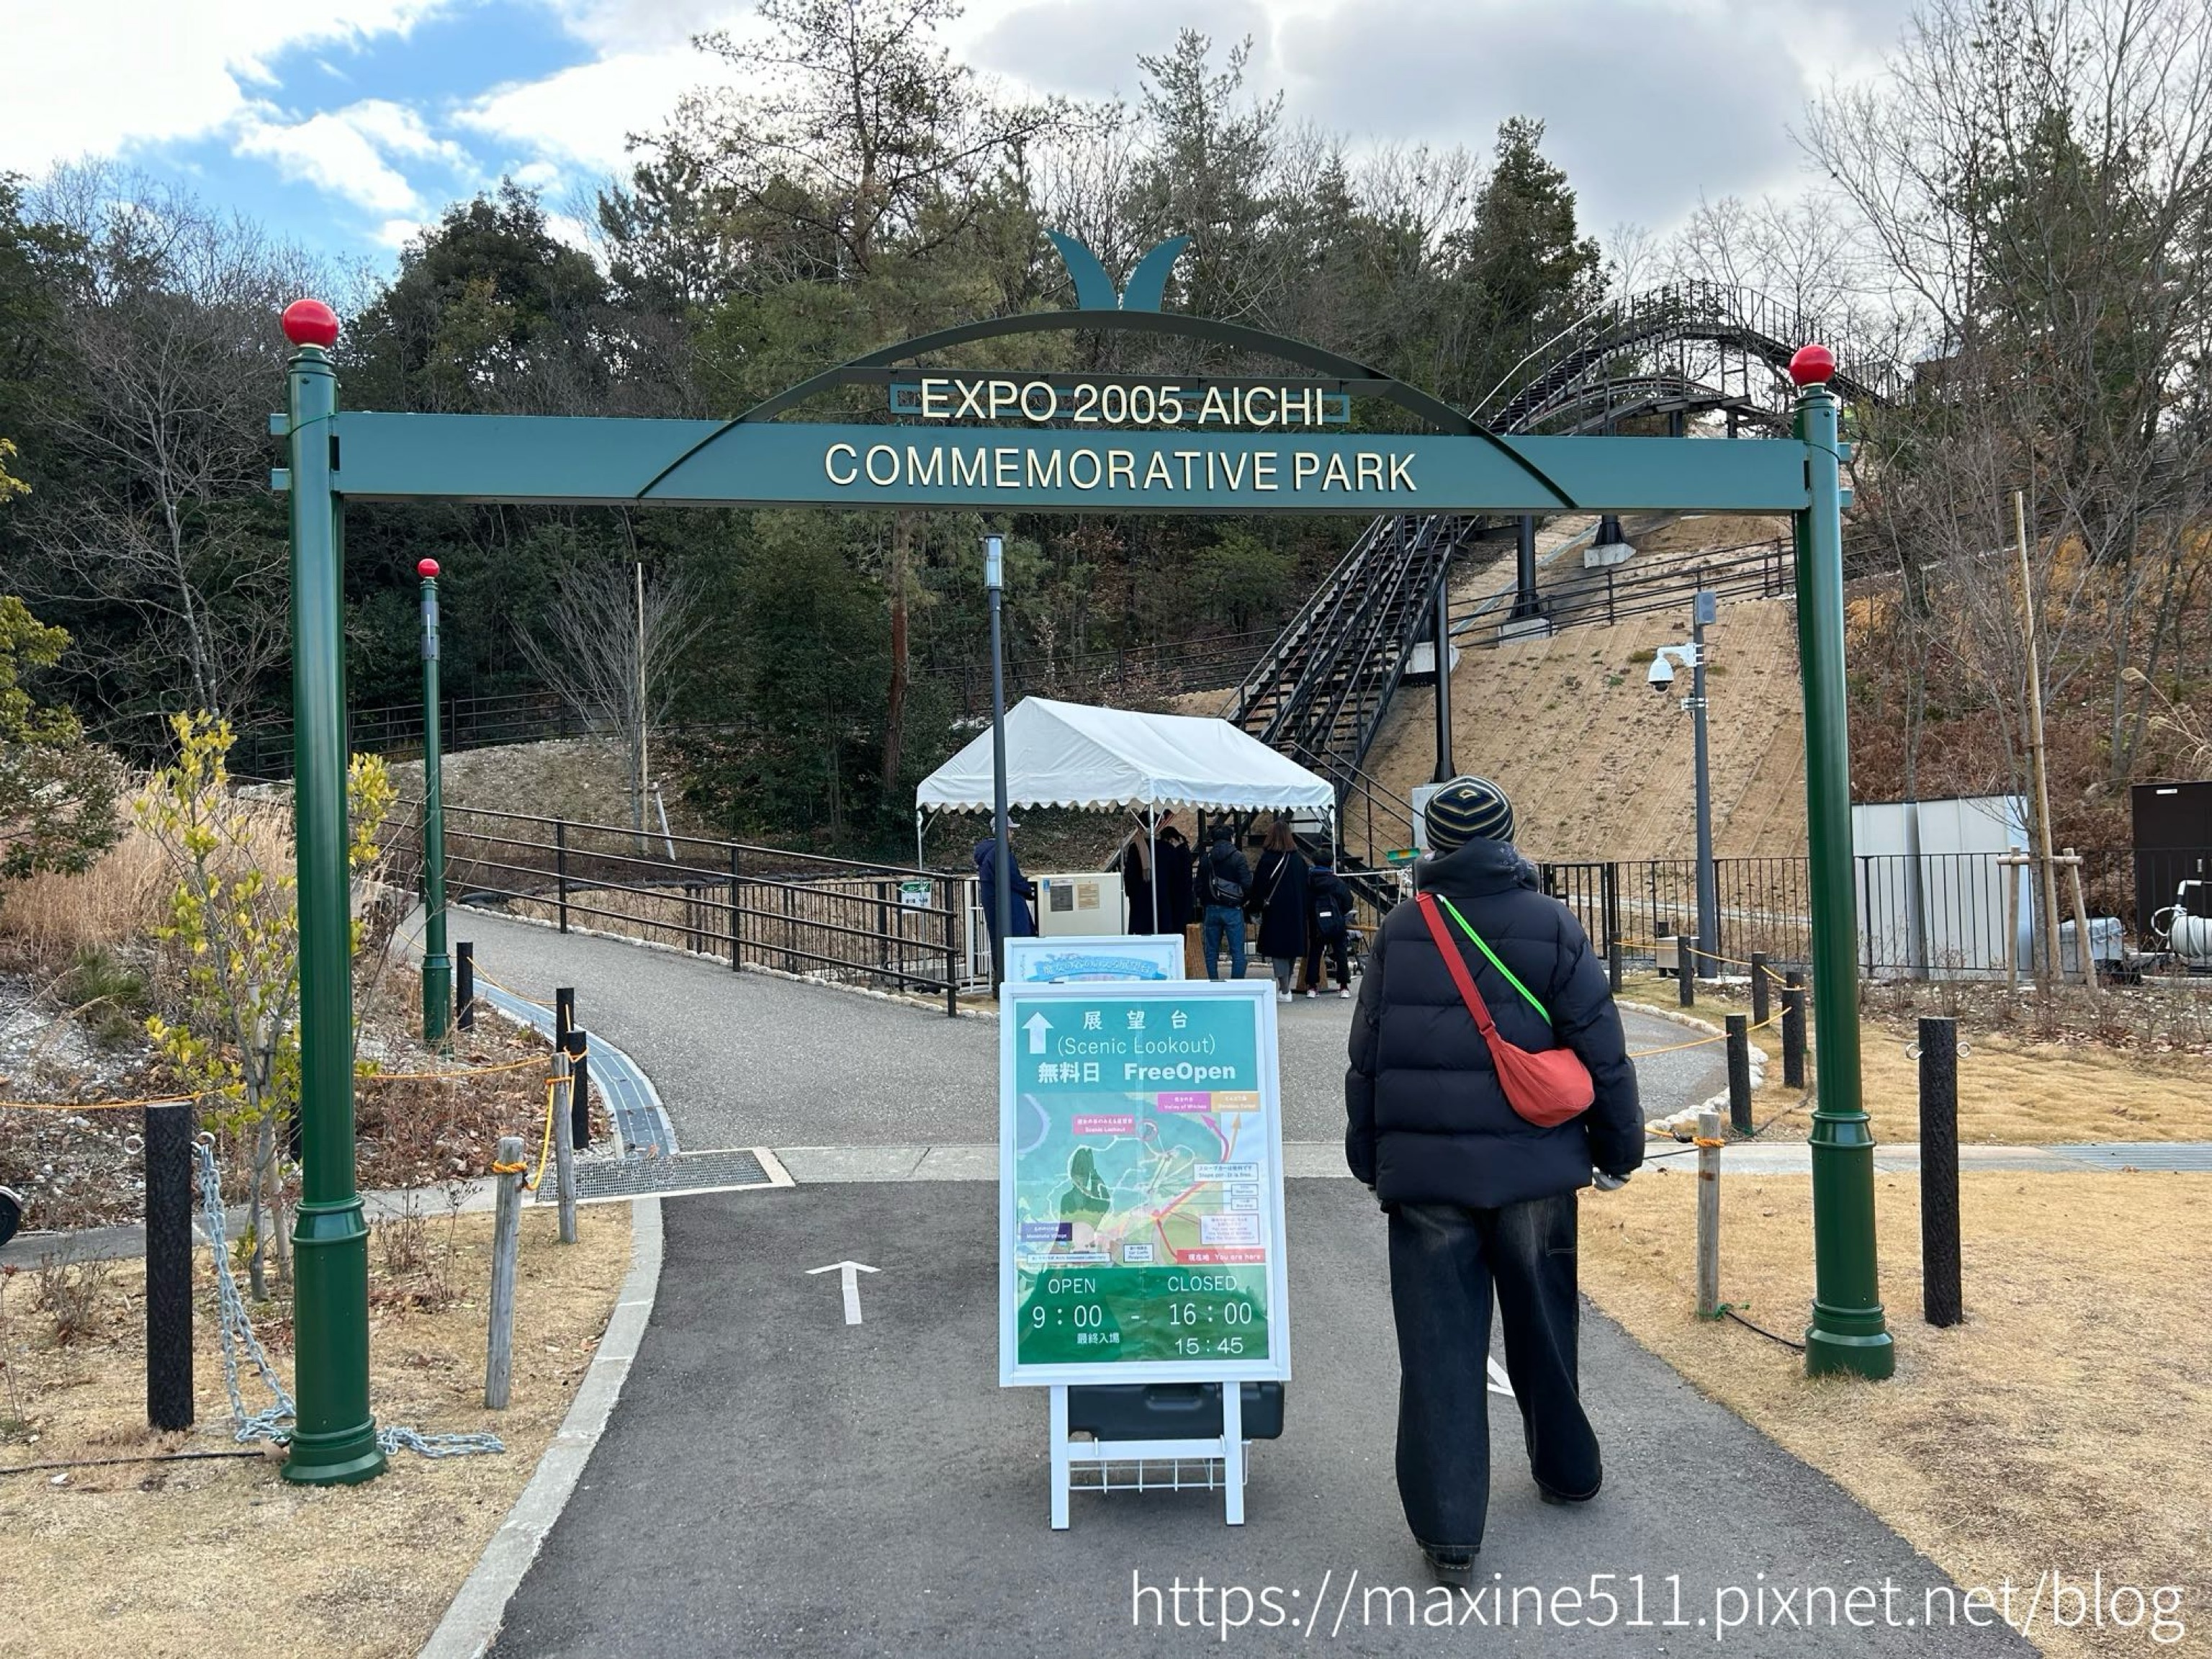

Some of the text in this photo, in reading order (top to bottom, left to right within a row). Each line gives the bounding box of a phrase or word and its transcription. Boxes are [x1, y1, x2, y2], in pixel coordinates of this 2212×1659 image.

[922, 378, 1323, 426] EXPO 2005 AICHI
[825, 444, 1417, 492] COMMEMORATIVE PARK
[1083, 1010, 1189, 1030] 展望台
[1058, 1034, 1216, 1056] (Scenic Lookout)
[1038, 1061, 1236, 1084] 無料日 FreeOpen
[1048, 1276, 1237, 1294] OPEN CLOSED
[1076, 1332, 1120, 1344] 最終入場
